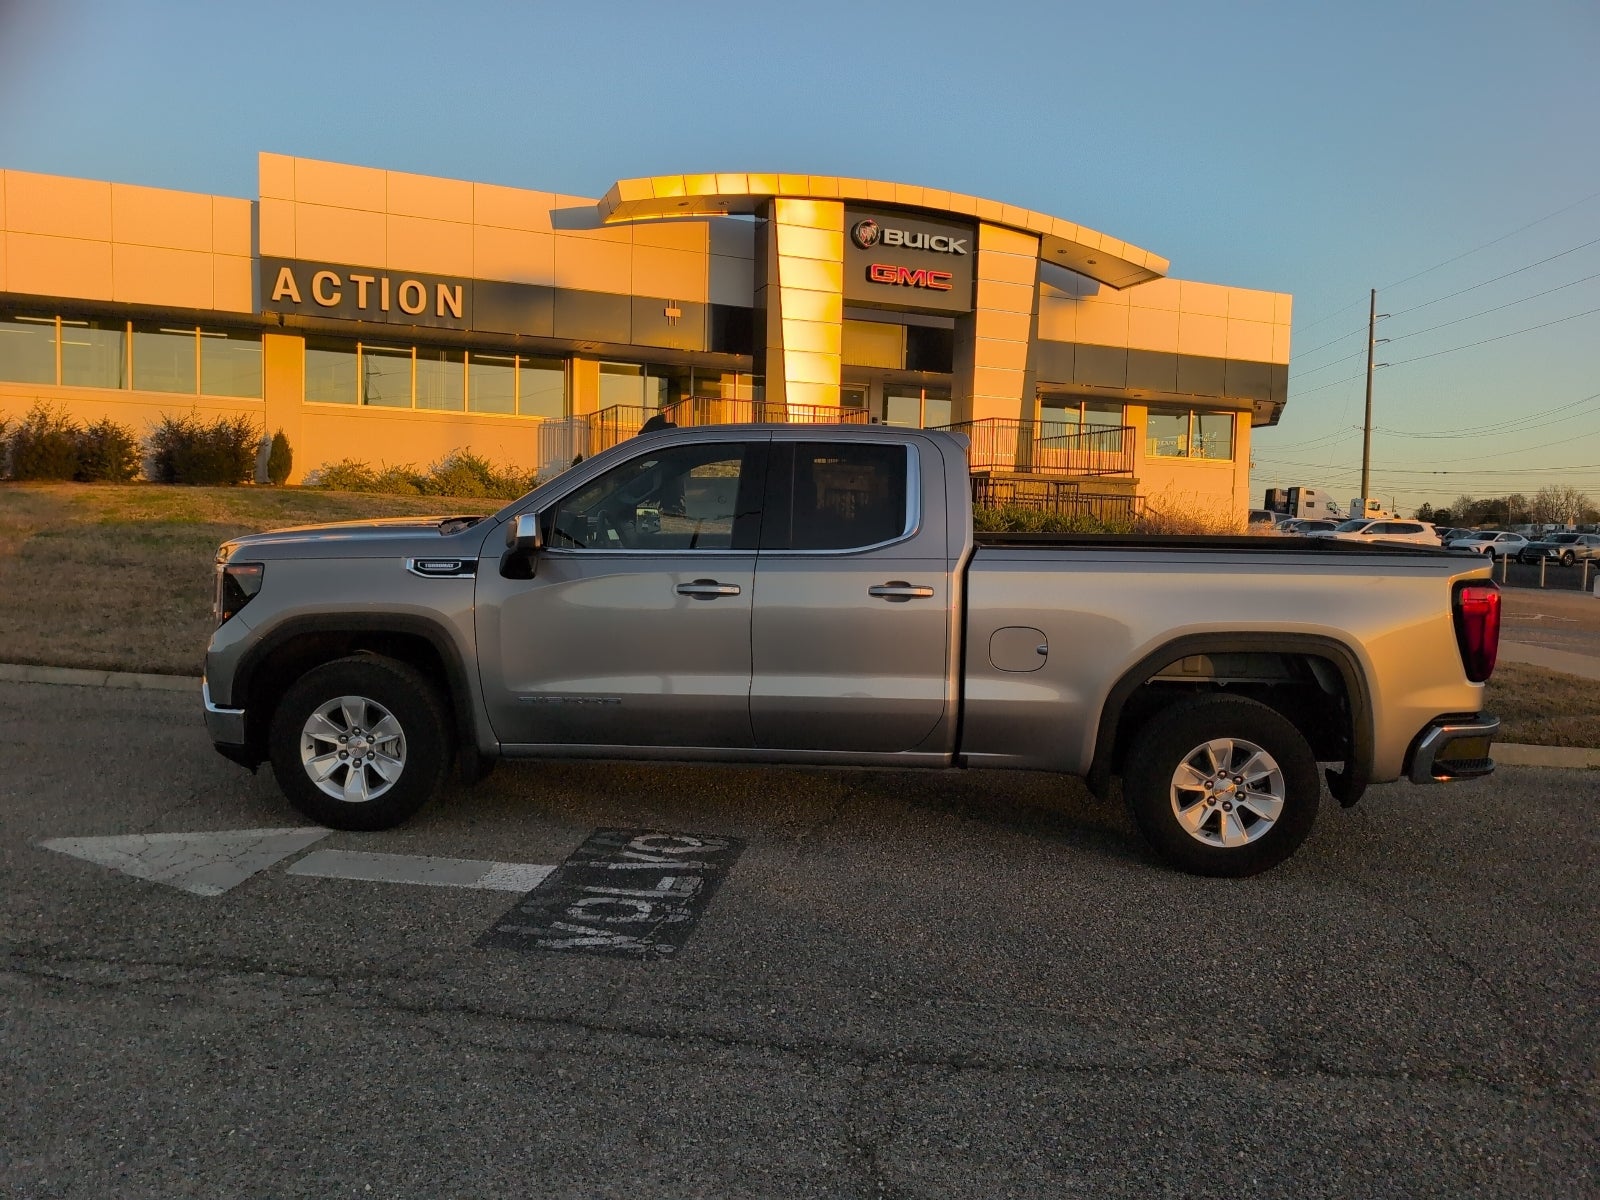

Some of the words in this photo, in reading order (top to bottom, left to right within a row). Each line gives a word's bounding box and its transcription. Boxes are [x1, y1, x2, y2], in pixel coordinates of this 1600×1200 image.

[883, 228, 967, 254] BUICK
[870, 263, 952, 290] GMC
[271, 267, 463, 318] ACTION
